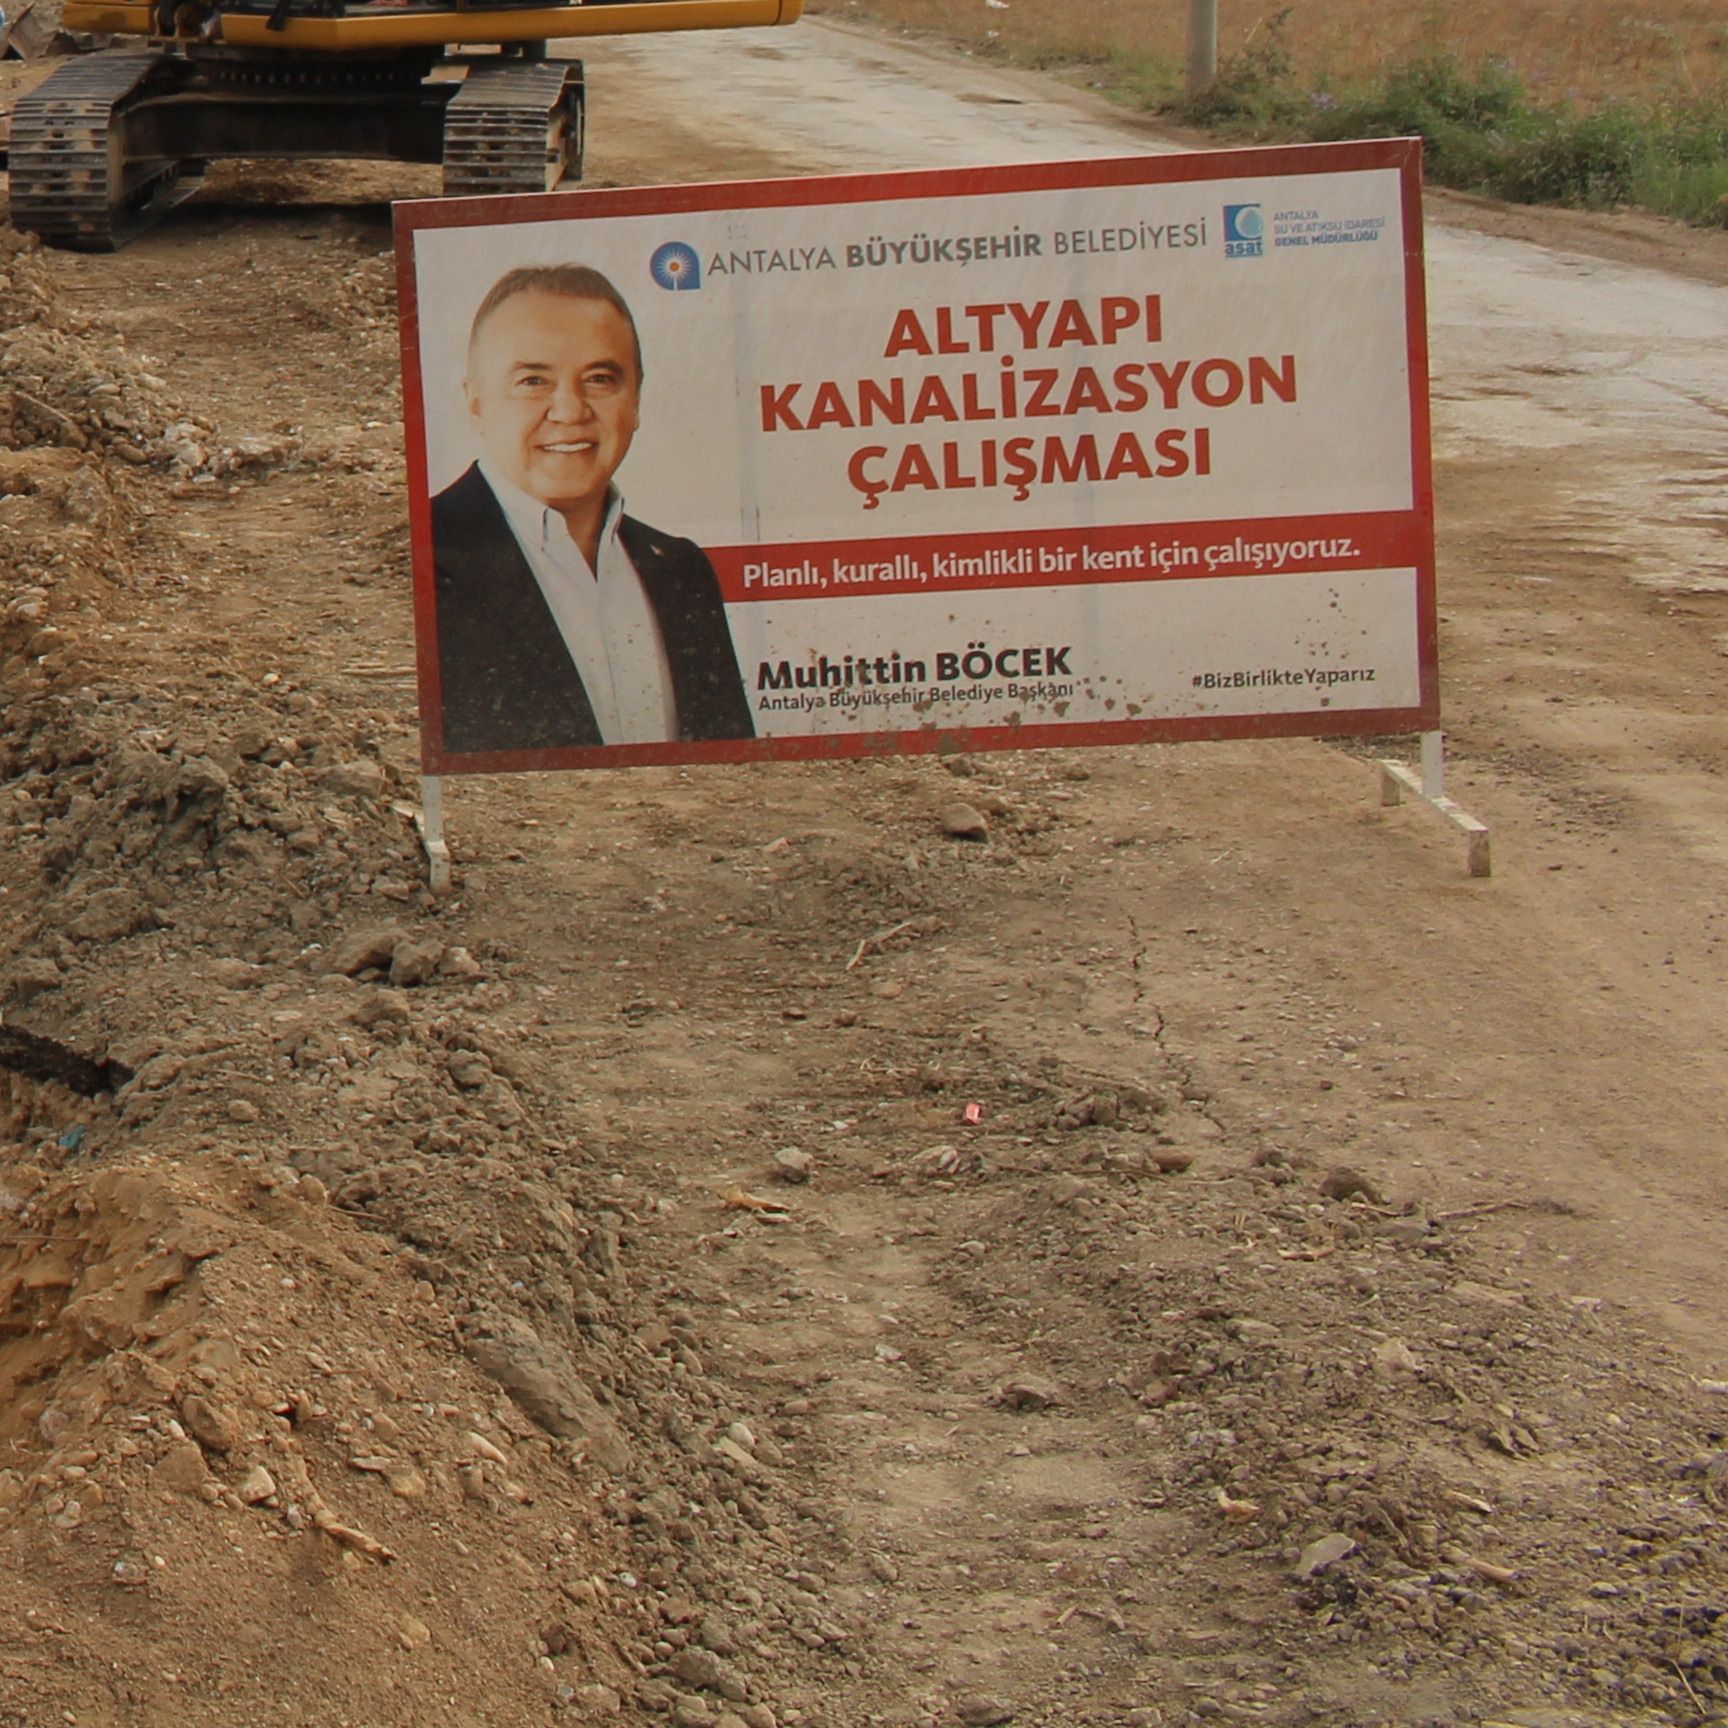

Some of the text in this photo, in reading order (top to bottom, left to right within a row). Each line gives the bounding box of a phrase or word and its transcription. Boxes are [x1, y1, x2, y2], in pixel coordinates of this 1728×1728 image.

[1273, 210, 1319, 221] ANTALYA
[1274, 224, 1288, 234] SU
[1289, 223, 1304, 233] VE
[707, 217, 1206, 276] ANTALYA BÜYÜKŞEHİR BELEDİYESİ
[1225, 241, 1263, 255] asat
[1275, 236, 1309, 247] GENEL
[883, 294, 1162, 358] ALTYAPI
[759, 354, 1298, 432] KANALİZASYON
[846, 427, 1211, 509] ÇALIŞMASI
[743, 536, 1361, 589] Planlı, kurallı, kimlikli bir kent için çalışıyoruz.
[757, 641, 1073, 690] Muhittin BÖCEK
[1192, 669, 1376, 689] #BizBirlikteYaparız
[759, 693, 826, 713] Antalya
[829, 686, 925, 710] Büyükşehir
[930, 683, 1003, 704] Belediye
